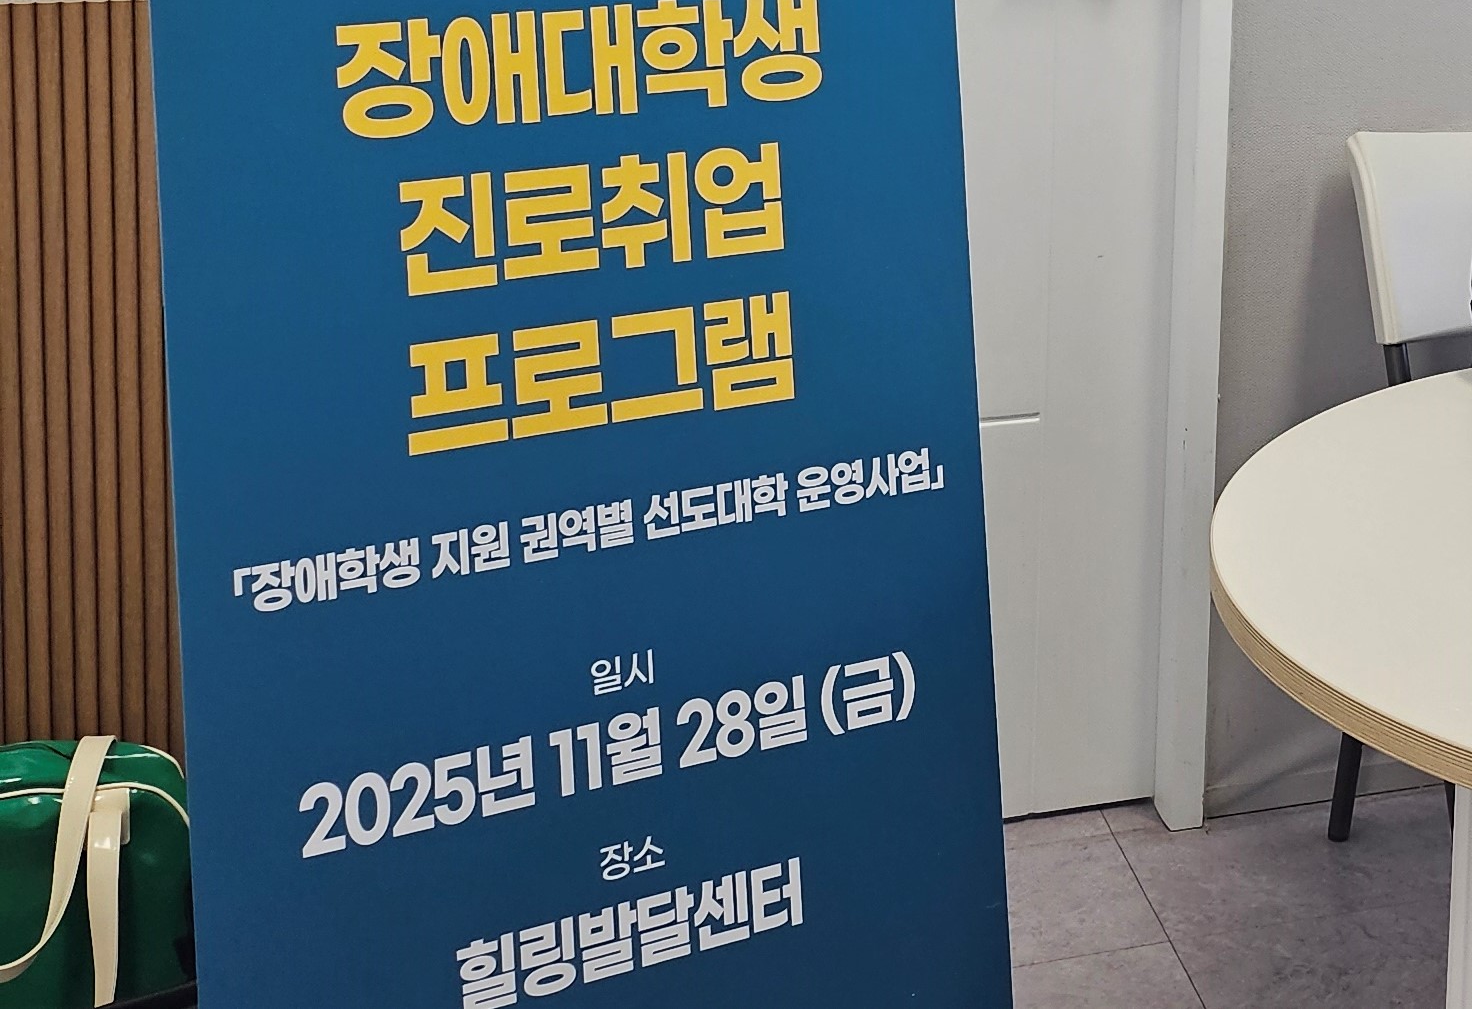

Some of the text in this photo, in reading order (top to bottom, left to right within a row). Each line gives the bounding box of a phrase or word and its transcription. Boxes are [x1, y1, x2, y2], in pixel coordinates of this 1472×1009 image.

[399, 142, 785, 297] 진로취업
[408, 291, 796, 456] 프로그램
[234, 448, 945, 611] 「장애학생 지원 권역별 선도대학 운영사업」
[591, 650, 653, 695] 일시
[299, 652, 915, 858] 2025년 11월 28일 (금)
[456, 856, 804, 1009] 힐링발달센터
[600, 836, 665, 880] 장소
